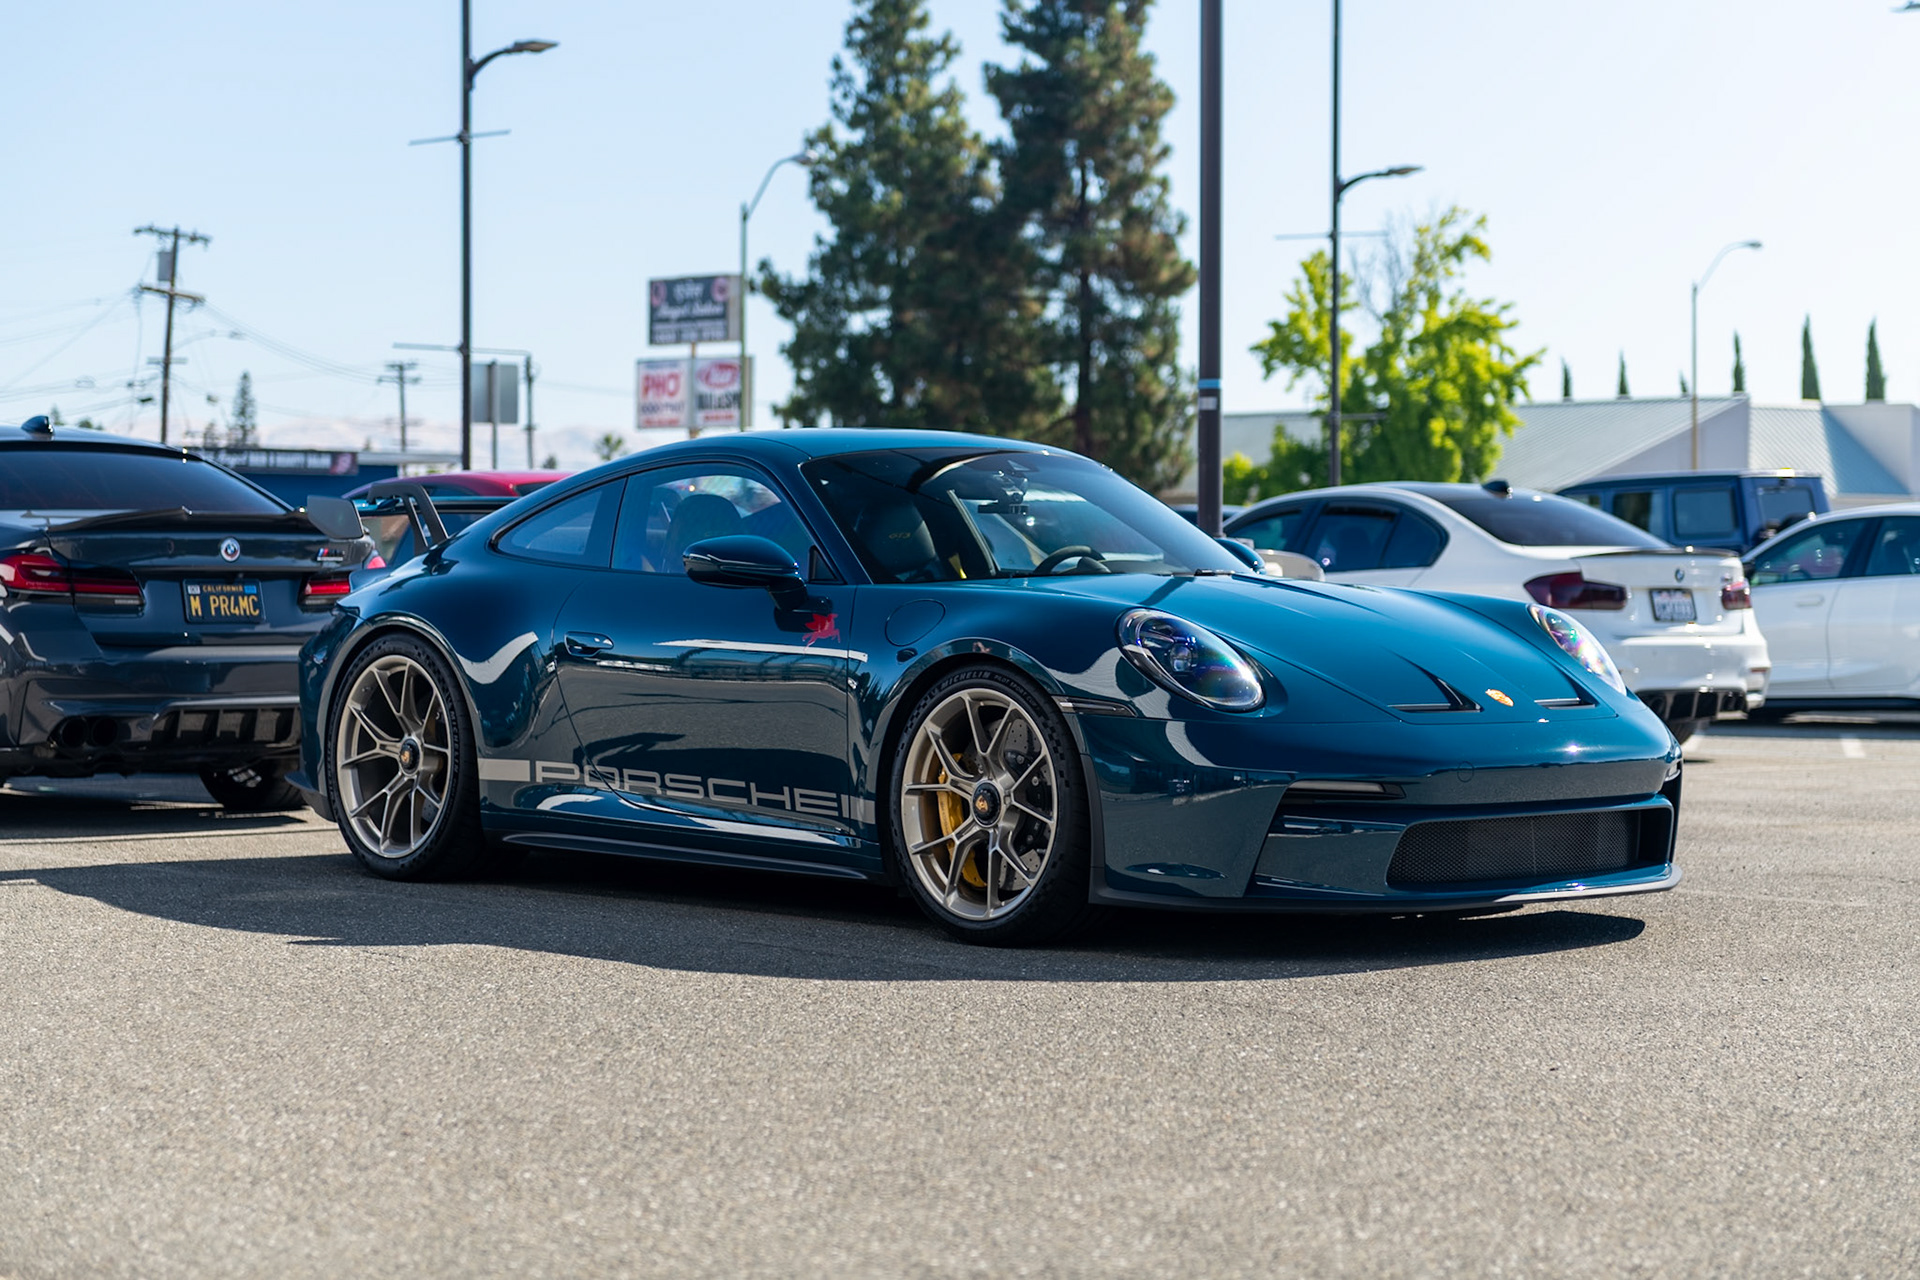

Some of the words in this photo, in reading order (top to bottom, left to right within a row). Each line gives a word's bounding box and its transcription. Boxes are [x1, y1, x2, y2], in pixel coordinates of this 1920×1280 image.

[642, 371, 681, 398] PHO
[202, 584, 243, 593] CALIFORNIA
[190, 595, 202, 616] M
[209, 595, 260, 616] PR4MC
[940, 670, 991, 688] MICHELIN
[994, 674, 1010, 684] PILOT
[449, 710, 460, 773] MICHELIN
[535, 760, 837, 816] PORSCHE
